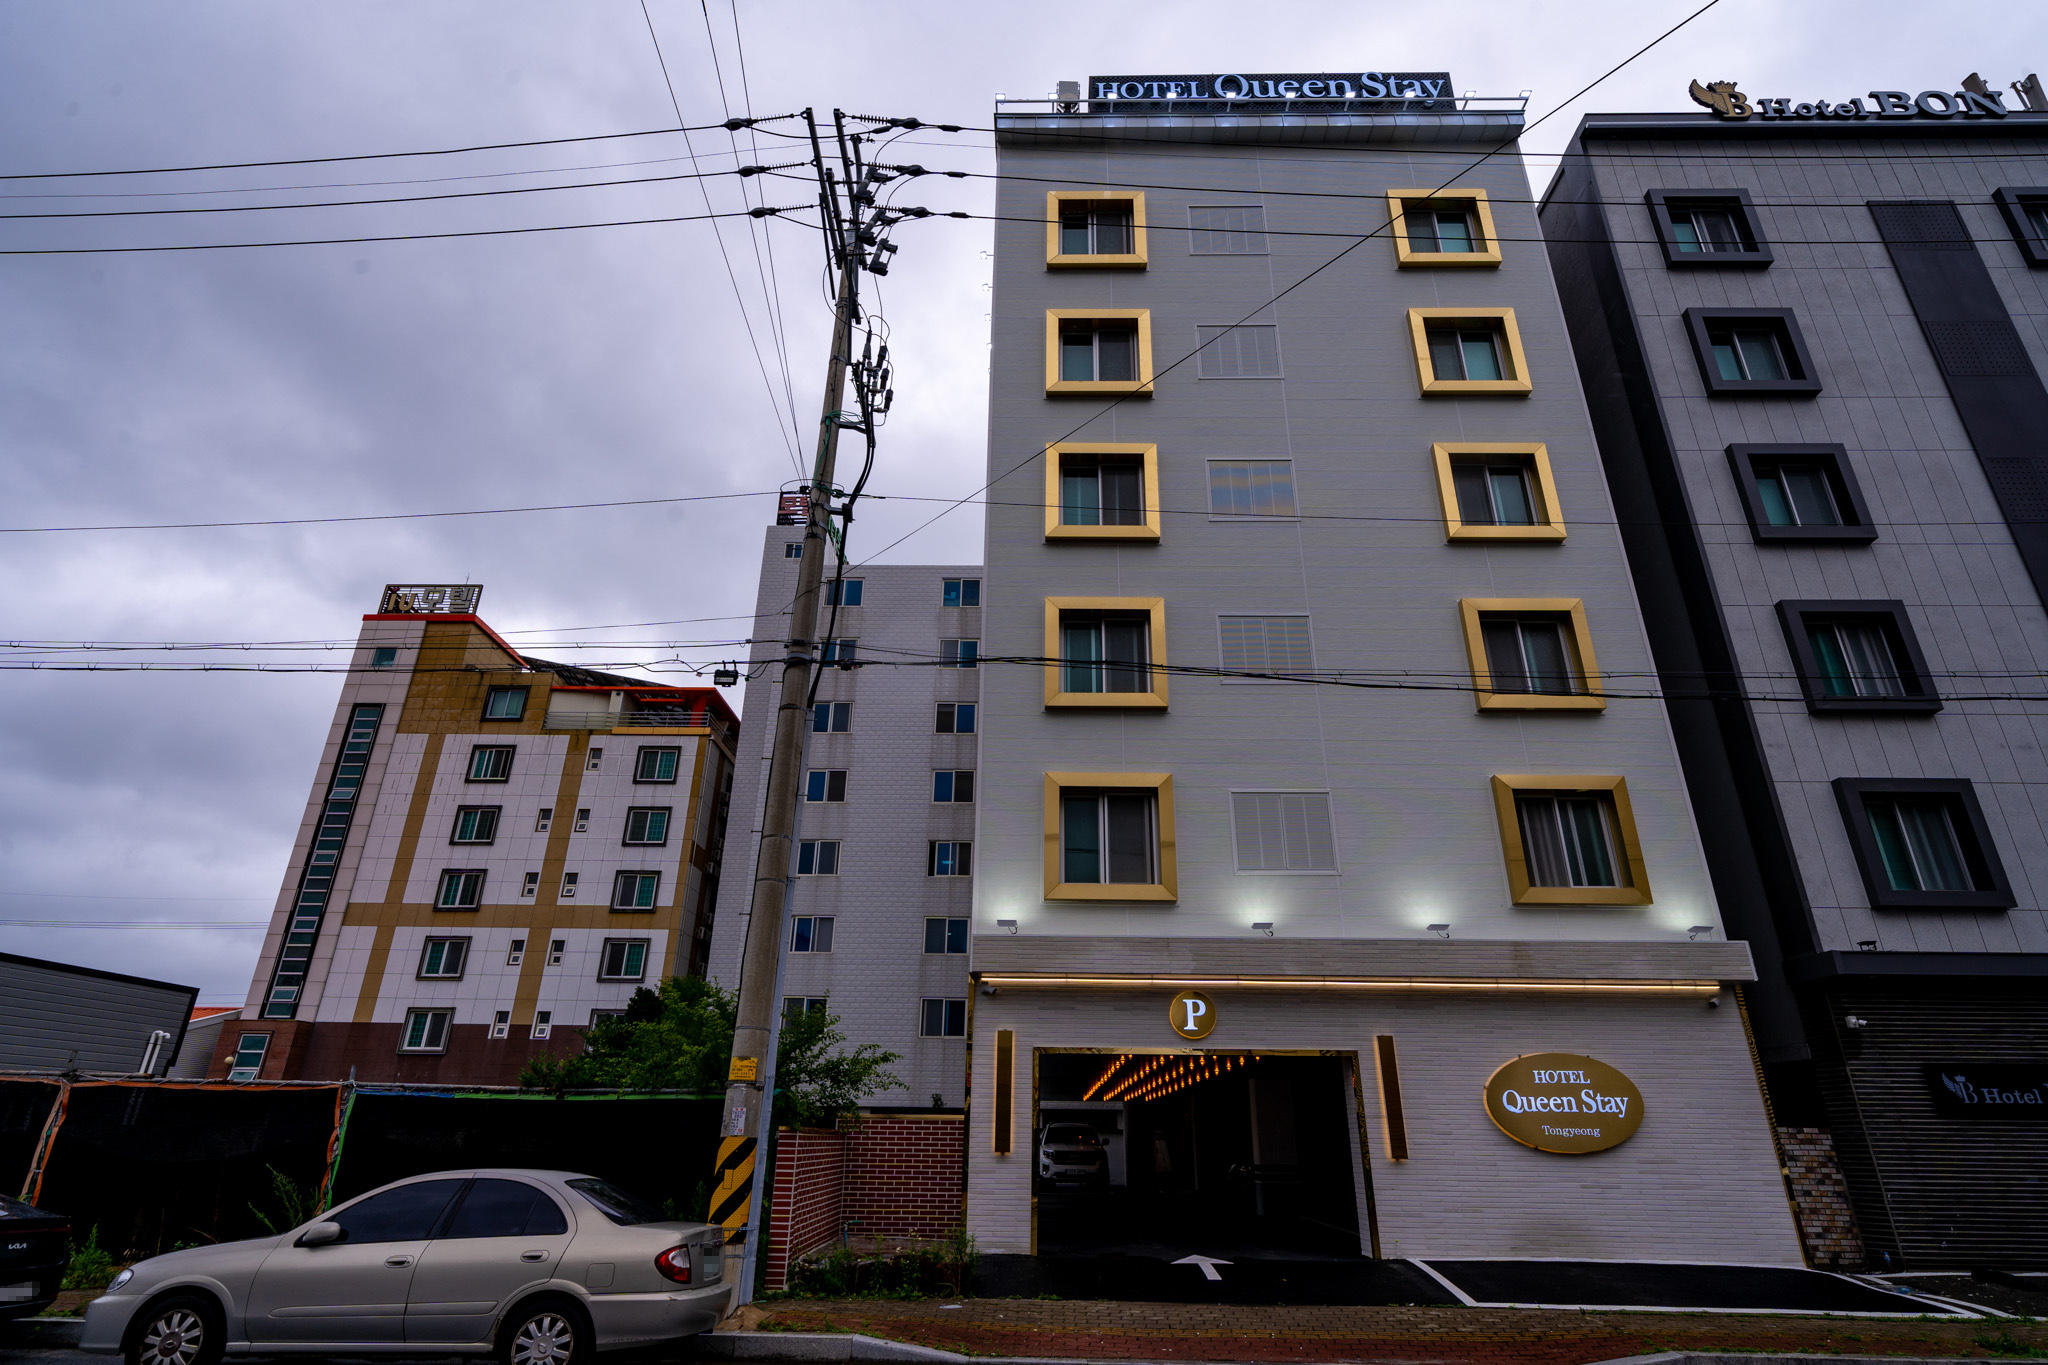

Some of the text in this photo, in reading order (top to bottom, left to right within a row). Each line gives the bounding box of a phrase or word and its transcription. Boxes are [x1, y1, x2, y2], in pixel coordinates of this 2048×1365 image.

[1095, 71, 1445, 105] HOTEL Queen Stay
[1757, 98, 1871, 119] Hotel
[1869, 90, 2009, 120] BON
[1182, 999, 1206, 1030] P
[1532, 1070, 1591, 1084] HOTEL
[1502, 1089, 1629, 1118] Queen Stay
[1980, 1088, 2044, 1104] Hotel
[1541, 1125, 1601, 1138] Tongyeong
